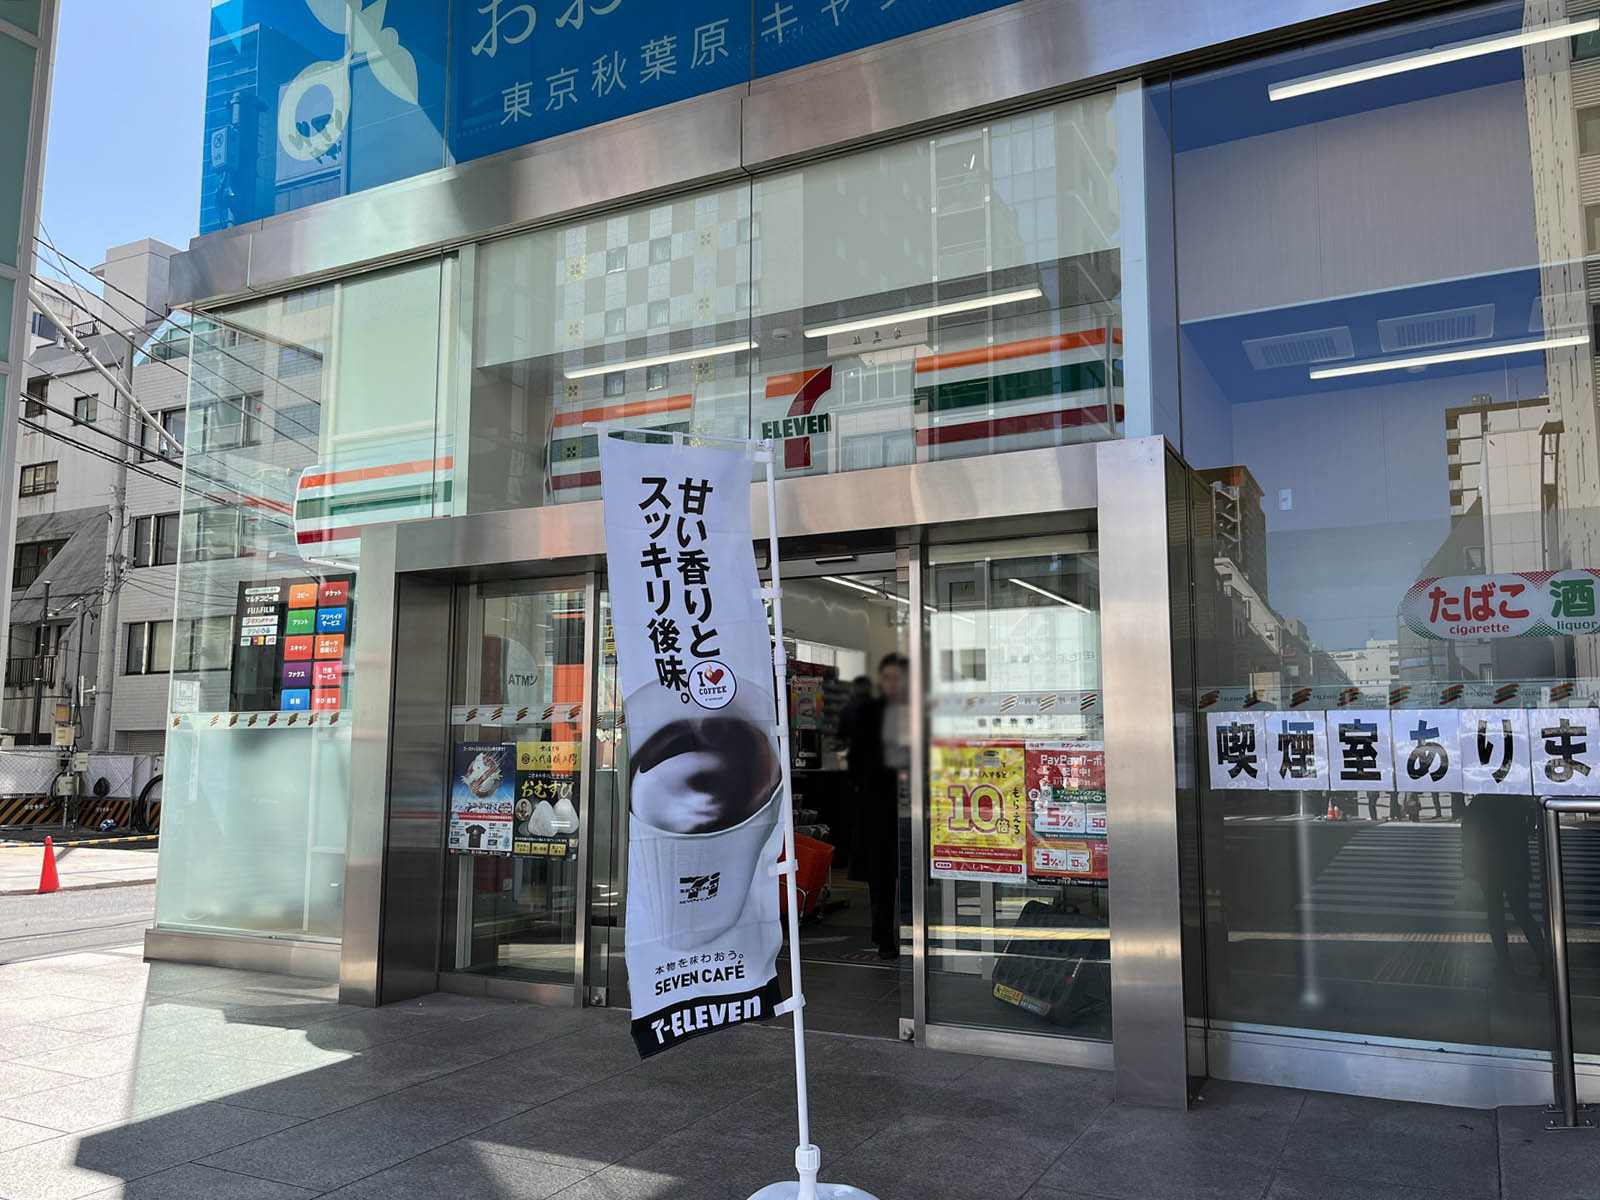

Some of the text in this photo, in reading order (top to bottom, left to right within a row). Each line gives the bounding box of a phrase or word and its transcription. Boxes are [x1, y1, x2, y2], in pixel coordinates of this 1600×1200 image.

[676, 477, 720, 659] 甘い香りと
[638, 476, 690, 705] スッキリ後味。
[1428, 578, 1595, 624] たばこ 酒
[1449, 620, 1597, 636] cigarette liquor
[508, 674, 531, 686] ATM
[697, 671, 706, 687] I
[698, 685, 728, 696] COFFEE
[1215, 718, 1591, 783] 喫煙室ありま
[521, 779, 575, 799] おむすび
[1012, 786, 1021, 835] もらえる
[654, 950, 744, 976] 本物を味わおう。
[655, 960, 745, 996] SEVEN CAFÉ
